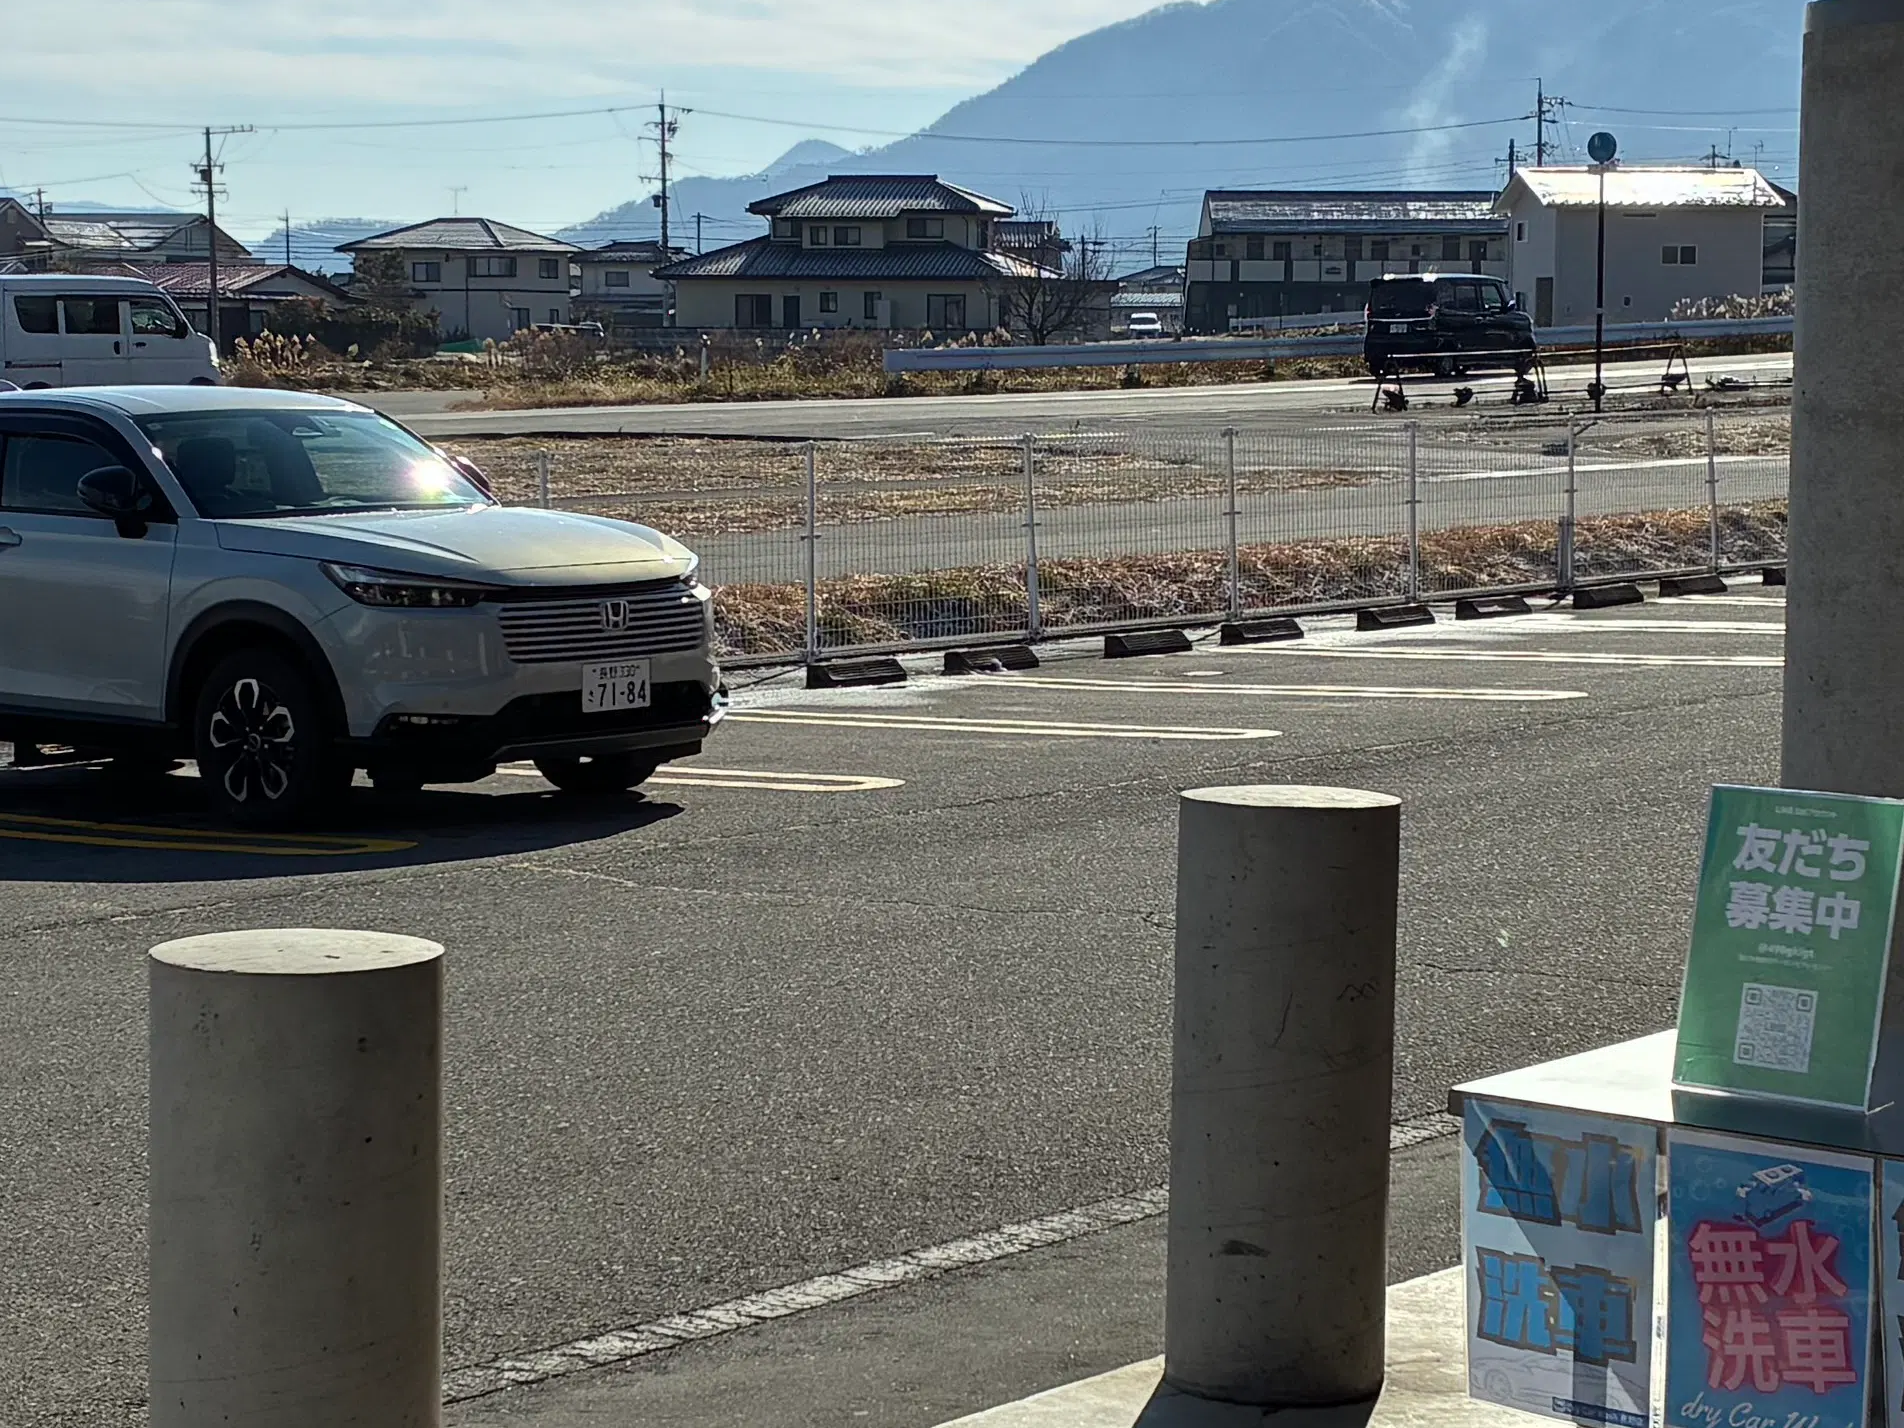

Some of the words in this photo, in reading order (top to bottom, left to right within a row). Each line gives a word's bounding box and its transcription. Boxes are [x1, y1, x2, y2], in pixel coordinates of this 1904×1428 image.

[597, 679, 647, 708] 71-84
[1732, 822, 1871, 882] 友だち
[1724, 881, 1862, 941] 募集中
[1688, 1221, 1848, 1304] 無水
[1475, 1245, 1637, 1368] 洗車
[1702, 1307, 1857, 1394] 洗車
